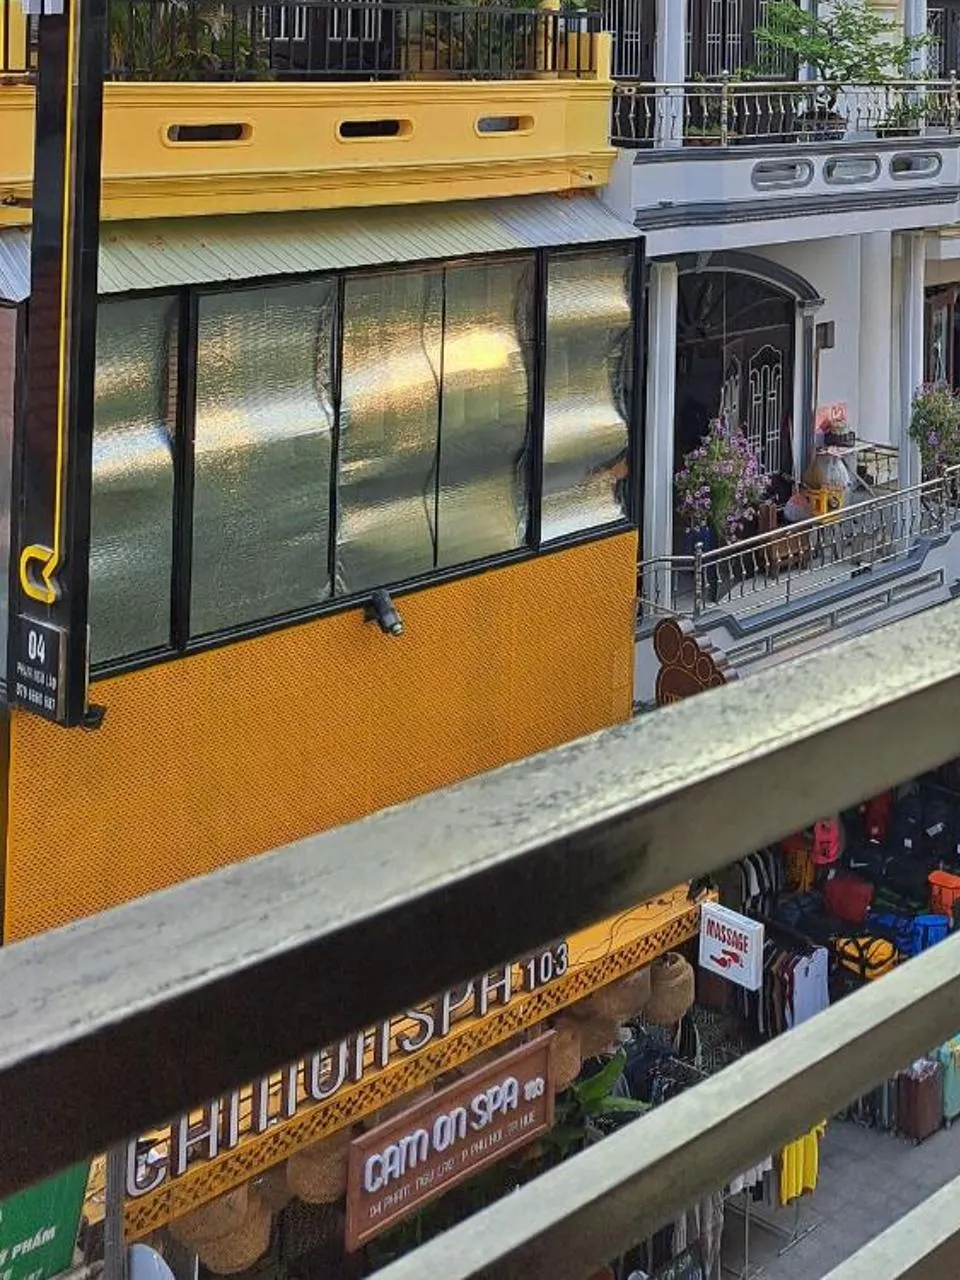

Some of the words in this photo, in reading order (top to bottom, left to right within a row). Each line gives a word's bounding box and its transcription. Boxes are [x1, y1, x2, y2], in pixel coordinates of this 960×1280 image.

[28, 630, 46, 664] 04
[705, 917, 749, 955] MASSAGE
[526, 941, 568, 991] 103
[471, 1075, 519, 1131] SPA
